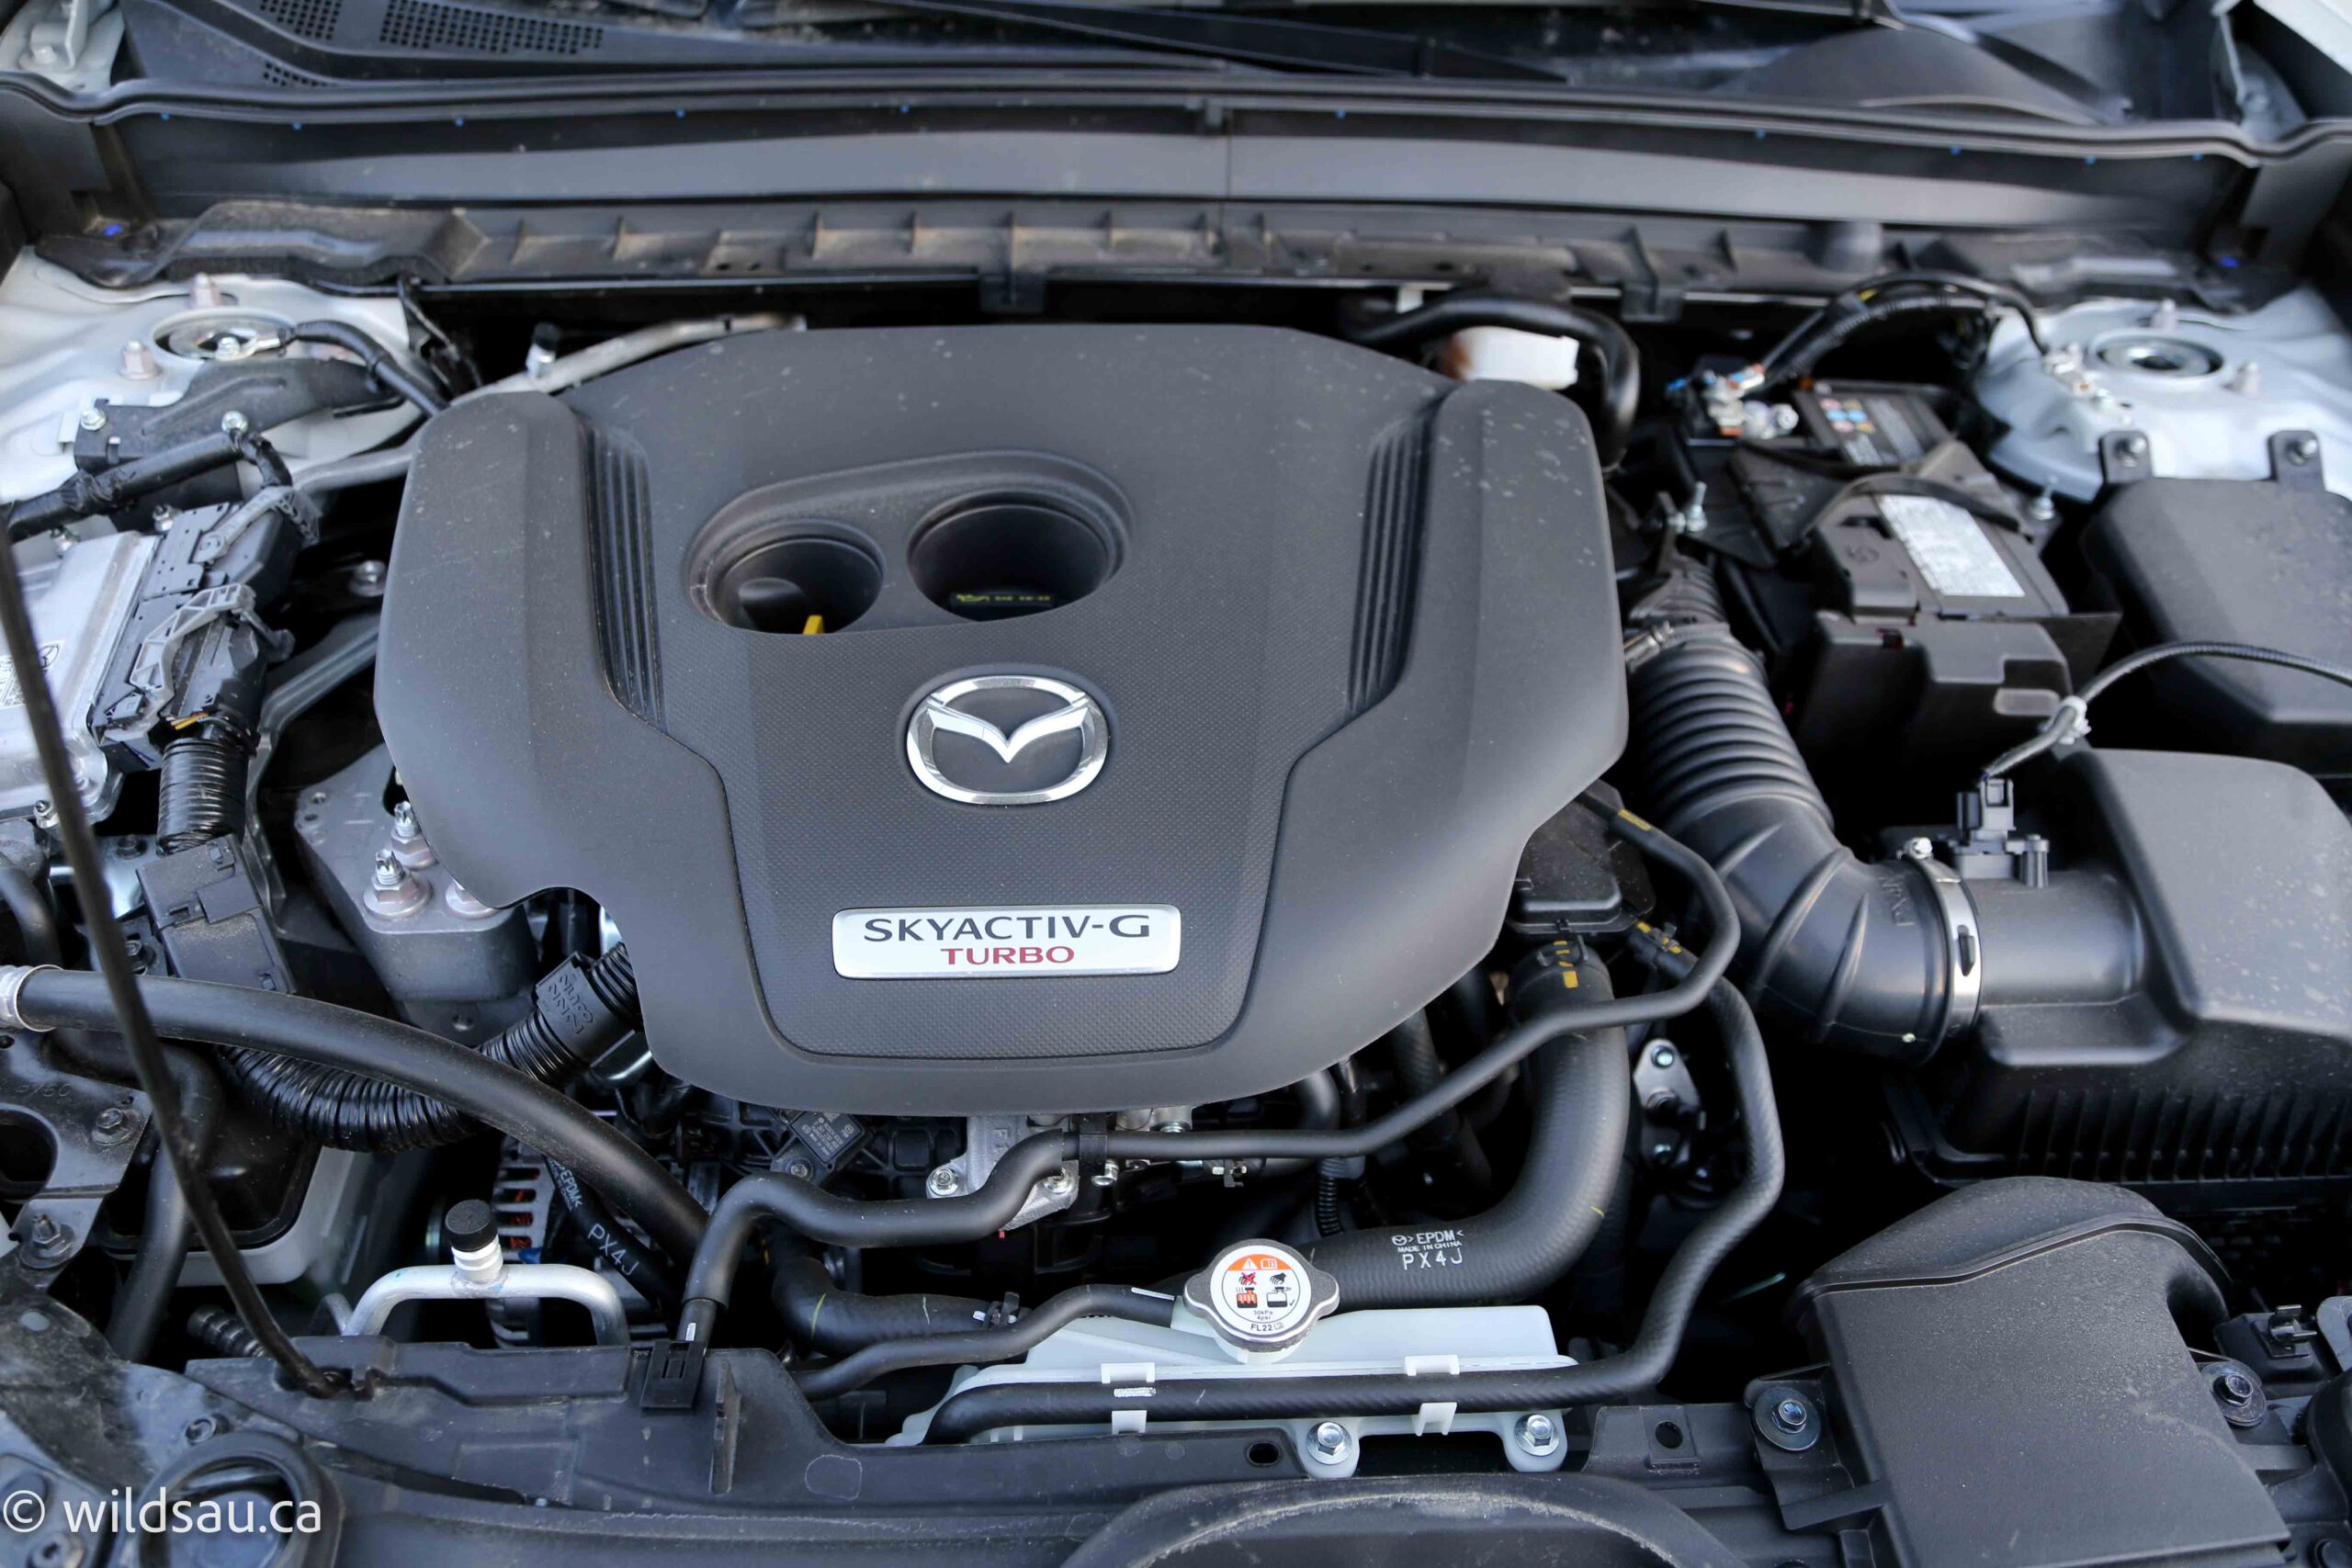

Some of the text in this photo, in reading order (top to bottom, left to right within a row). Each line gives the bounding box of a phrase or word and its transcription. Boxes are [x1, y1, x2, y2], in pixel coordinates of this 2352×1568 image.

[864, 915, 1150, 942] SKYACTIV-G
[940, 945, 1075, 965] TURBO
[587, 1224, 639, 1276] PX4J
[1434, 1240, 1463, 1249] CHINA
[1402, 1247, 1463, 1270] PX4J
[1250, 1323, 1272, 1332] FL22
